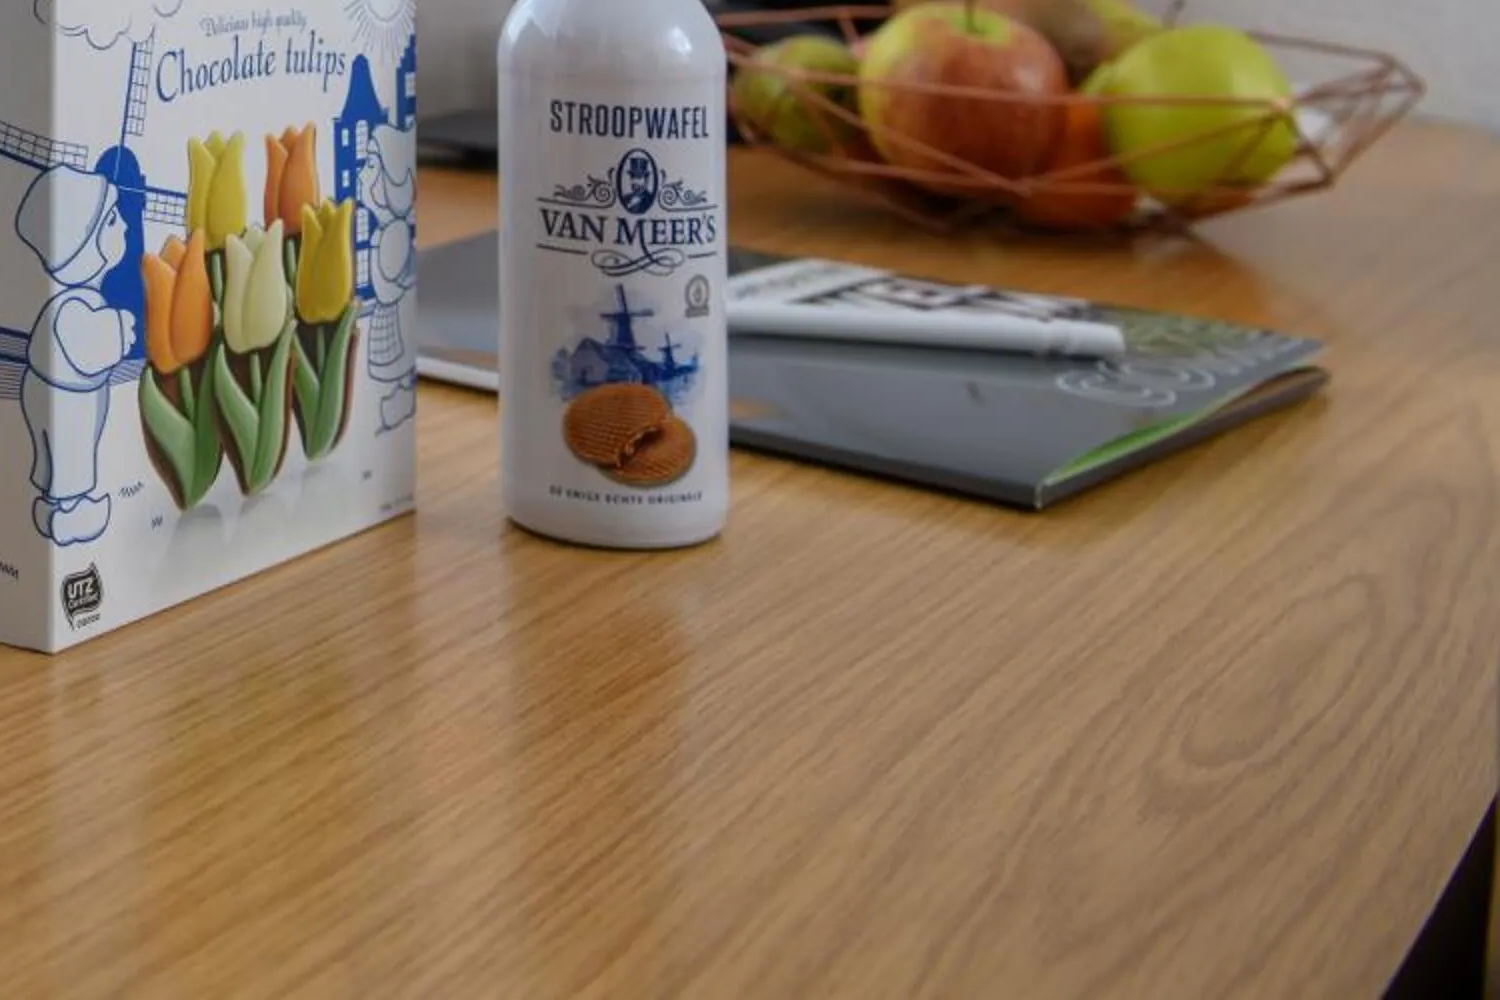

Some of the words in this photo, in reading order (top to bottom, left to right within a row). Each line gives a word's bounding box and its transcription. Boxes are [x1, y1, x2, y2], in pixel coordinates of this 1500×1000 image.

[156, 34, 277, 102] Chocolate
[285, 30, 347, 93] tulips
[550, 99, 709, 139] STROOPWAFEL
[540, 208, 608, 244] VAN
[614, 213, 717, 252] MEER'S
[67, 576, 96, 600] UTZ
